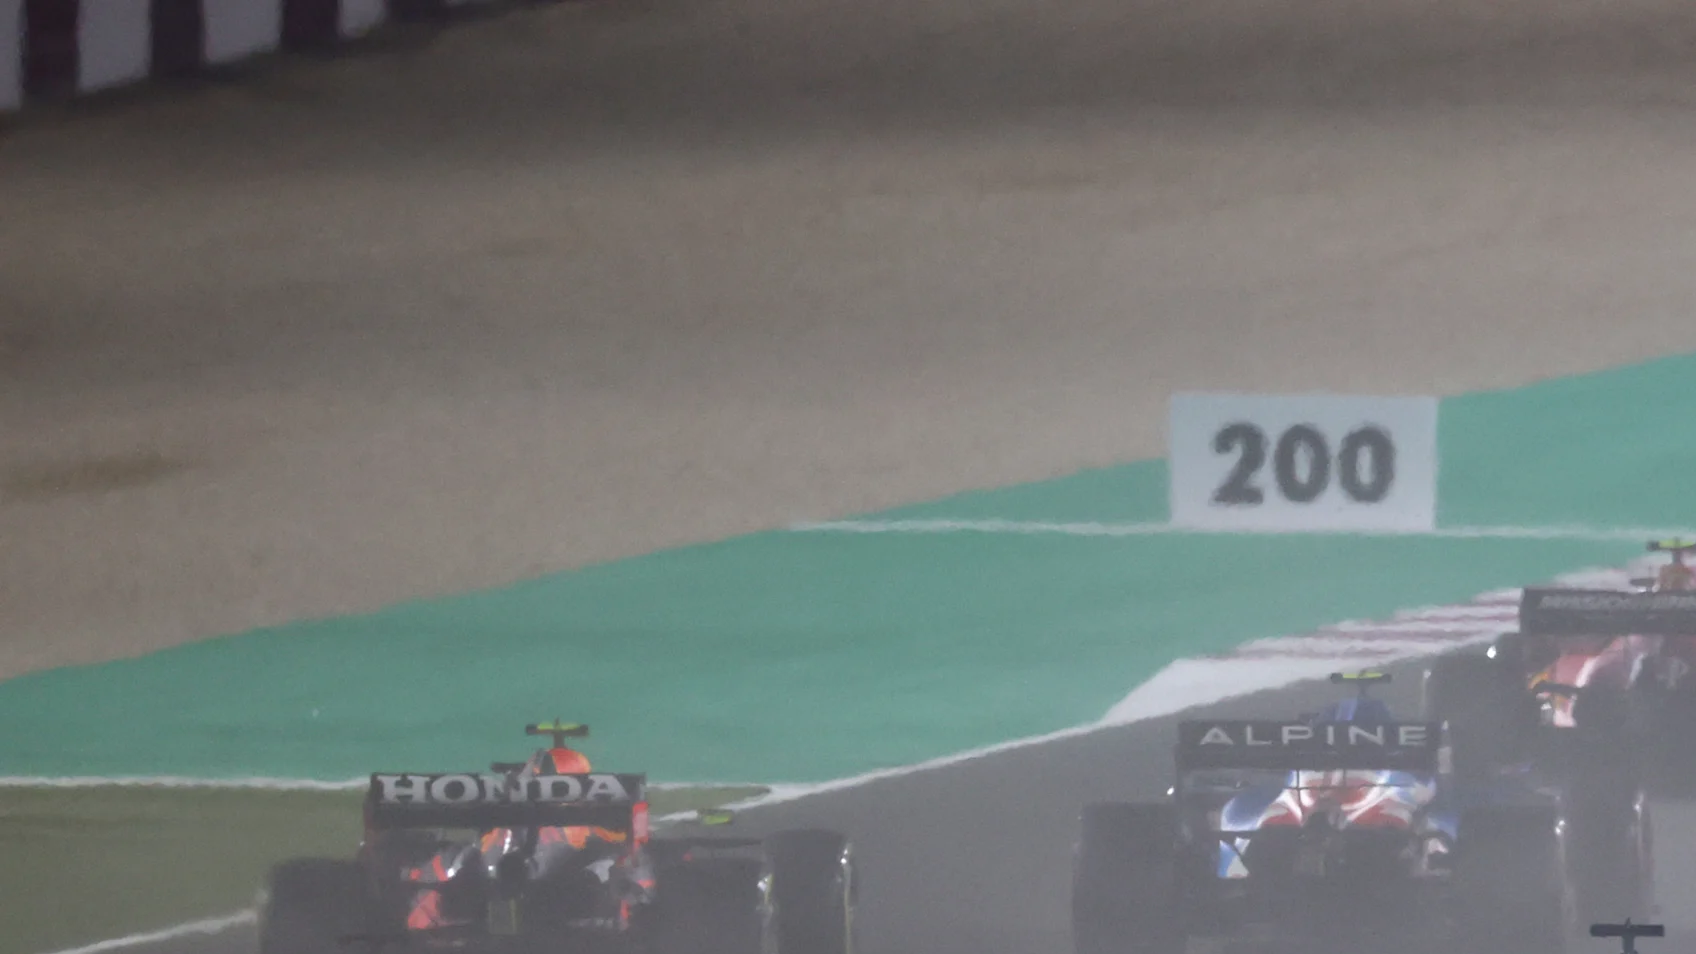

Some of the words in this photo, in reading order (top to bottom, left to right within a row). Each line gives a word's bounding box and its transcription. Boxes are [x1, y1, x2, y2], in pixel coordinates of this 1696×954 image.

[1209, 421, 1397, 505] 200
[1200, 725, 1428, 746] ALPINE
[377, 773, 630, 804] HONDA
